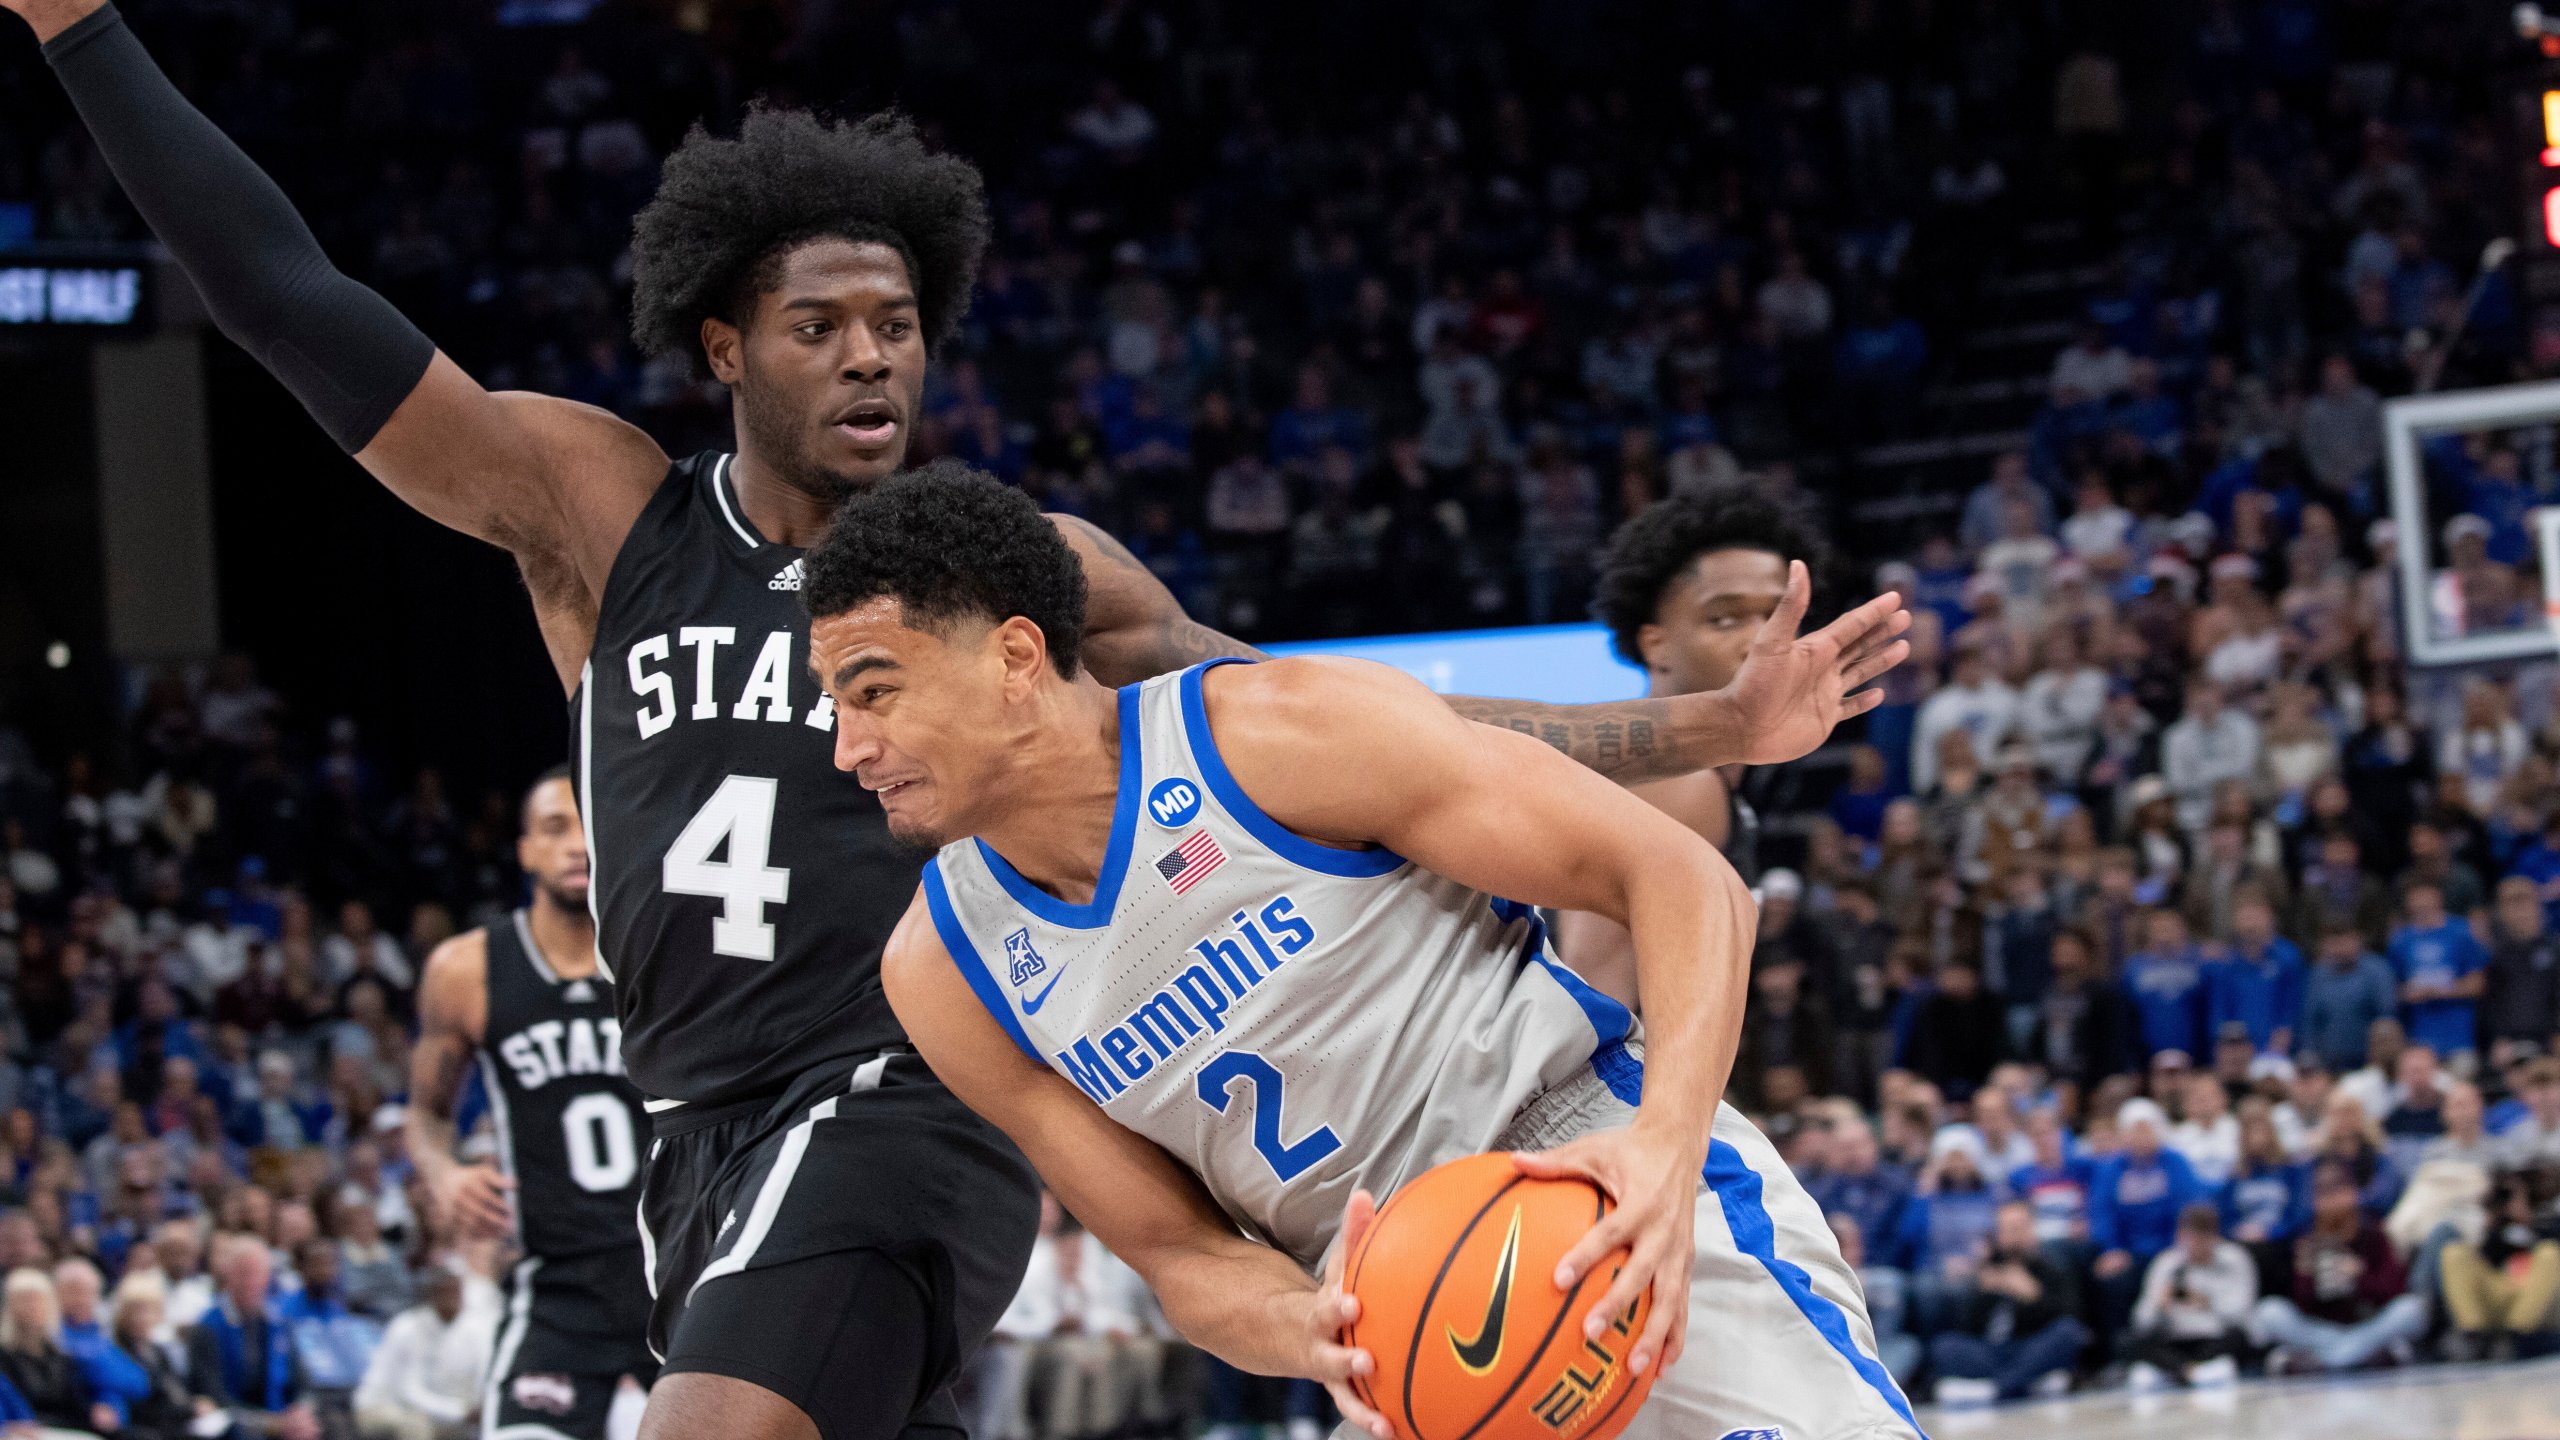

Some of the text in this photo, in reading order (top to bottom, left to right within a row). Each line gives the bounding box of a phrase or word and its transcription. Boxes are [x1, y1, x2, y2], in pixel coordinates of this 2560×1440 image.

[663, 774, 791, 962] 4
[1151, 784, 1195, 823] MD
[1052, 894, 1318, 1107] Memphis
[561, 1091, 638, 1193] 0
[1194, 1048, 1346, 1188] 2
